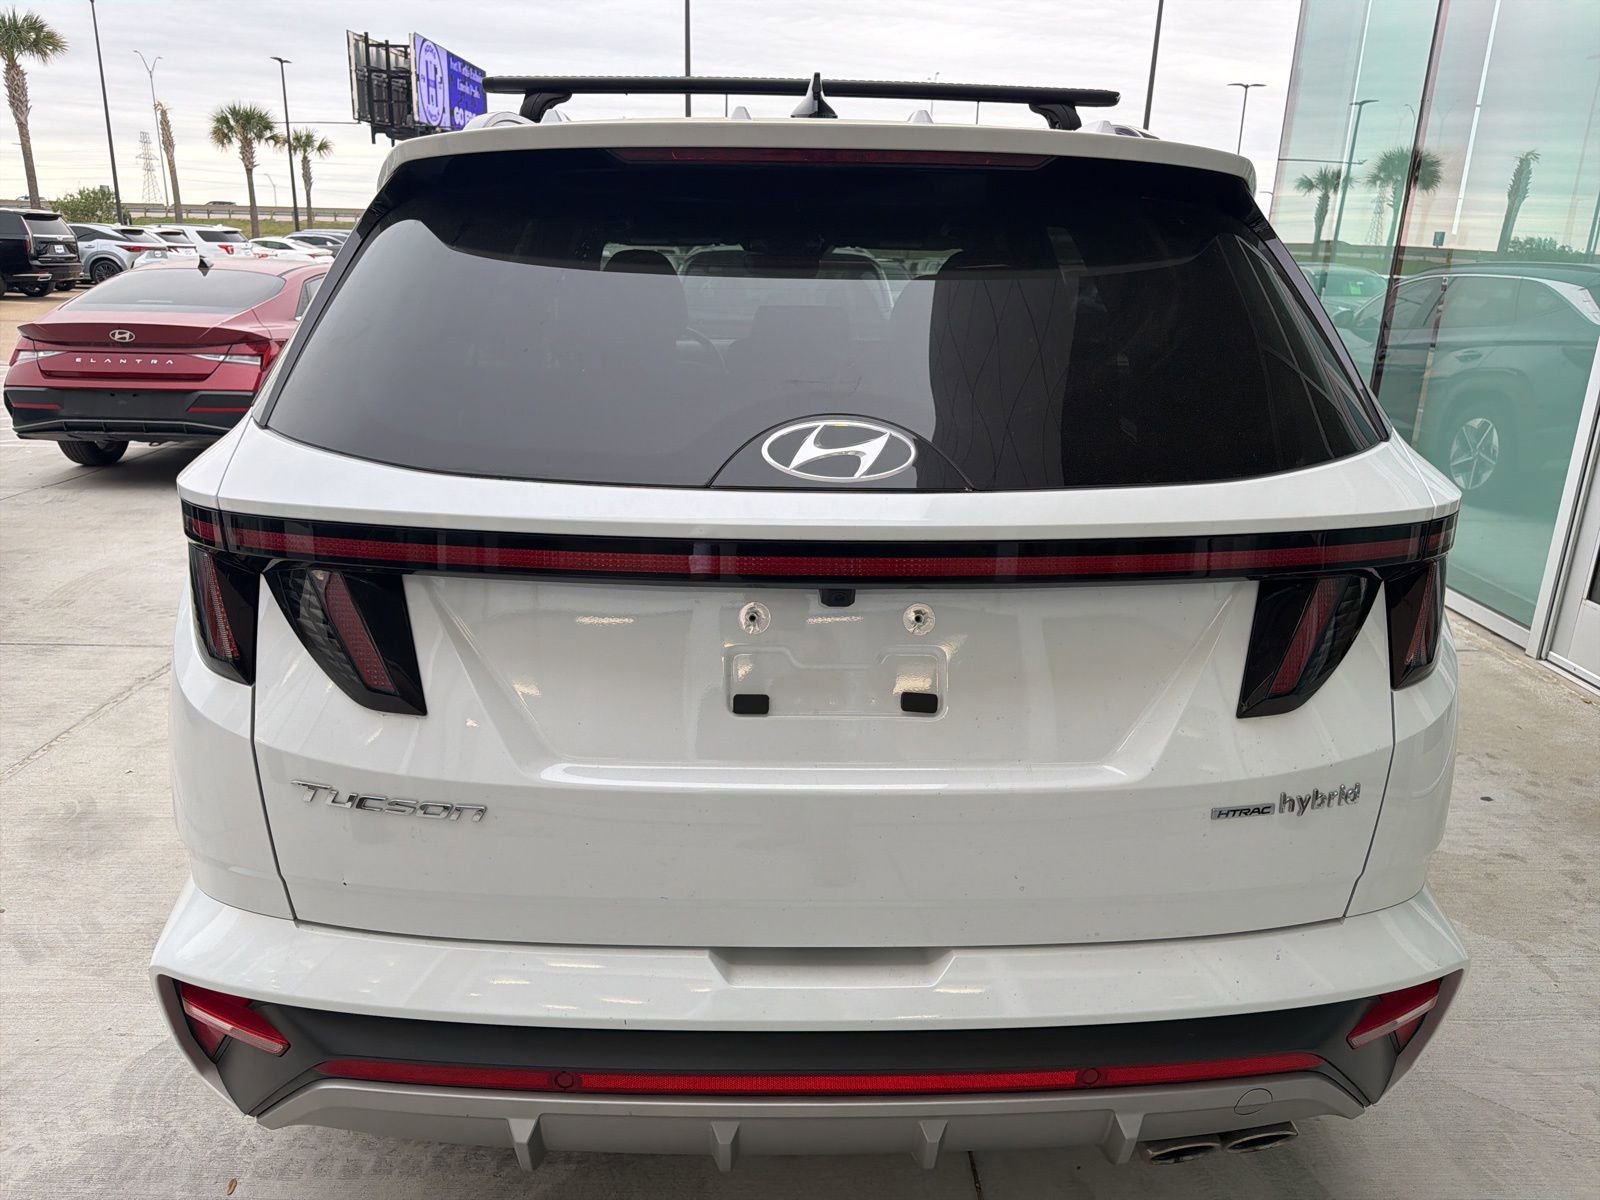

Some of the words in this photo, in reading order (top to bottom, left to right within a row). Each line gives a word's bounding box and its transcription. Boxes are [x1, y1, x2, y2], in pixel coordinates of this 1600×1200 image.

[75, 357, 174, 365] ELANTRA
[291, 780, 488, 822] TUCSON
[1216, 805, 1272, 819] HTRAC
[1278, 782, 1361, 816] hybrid
